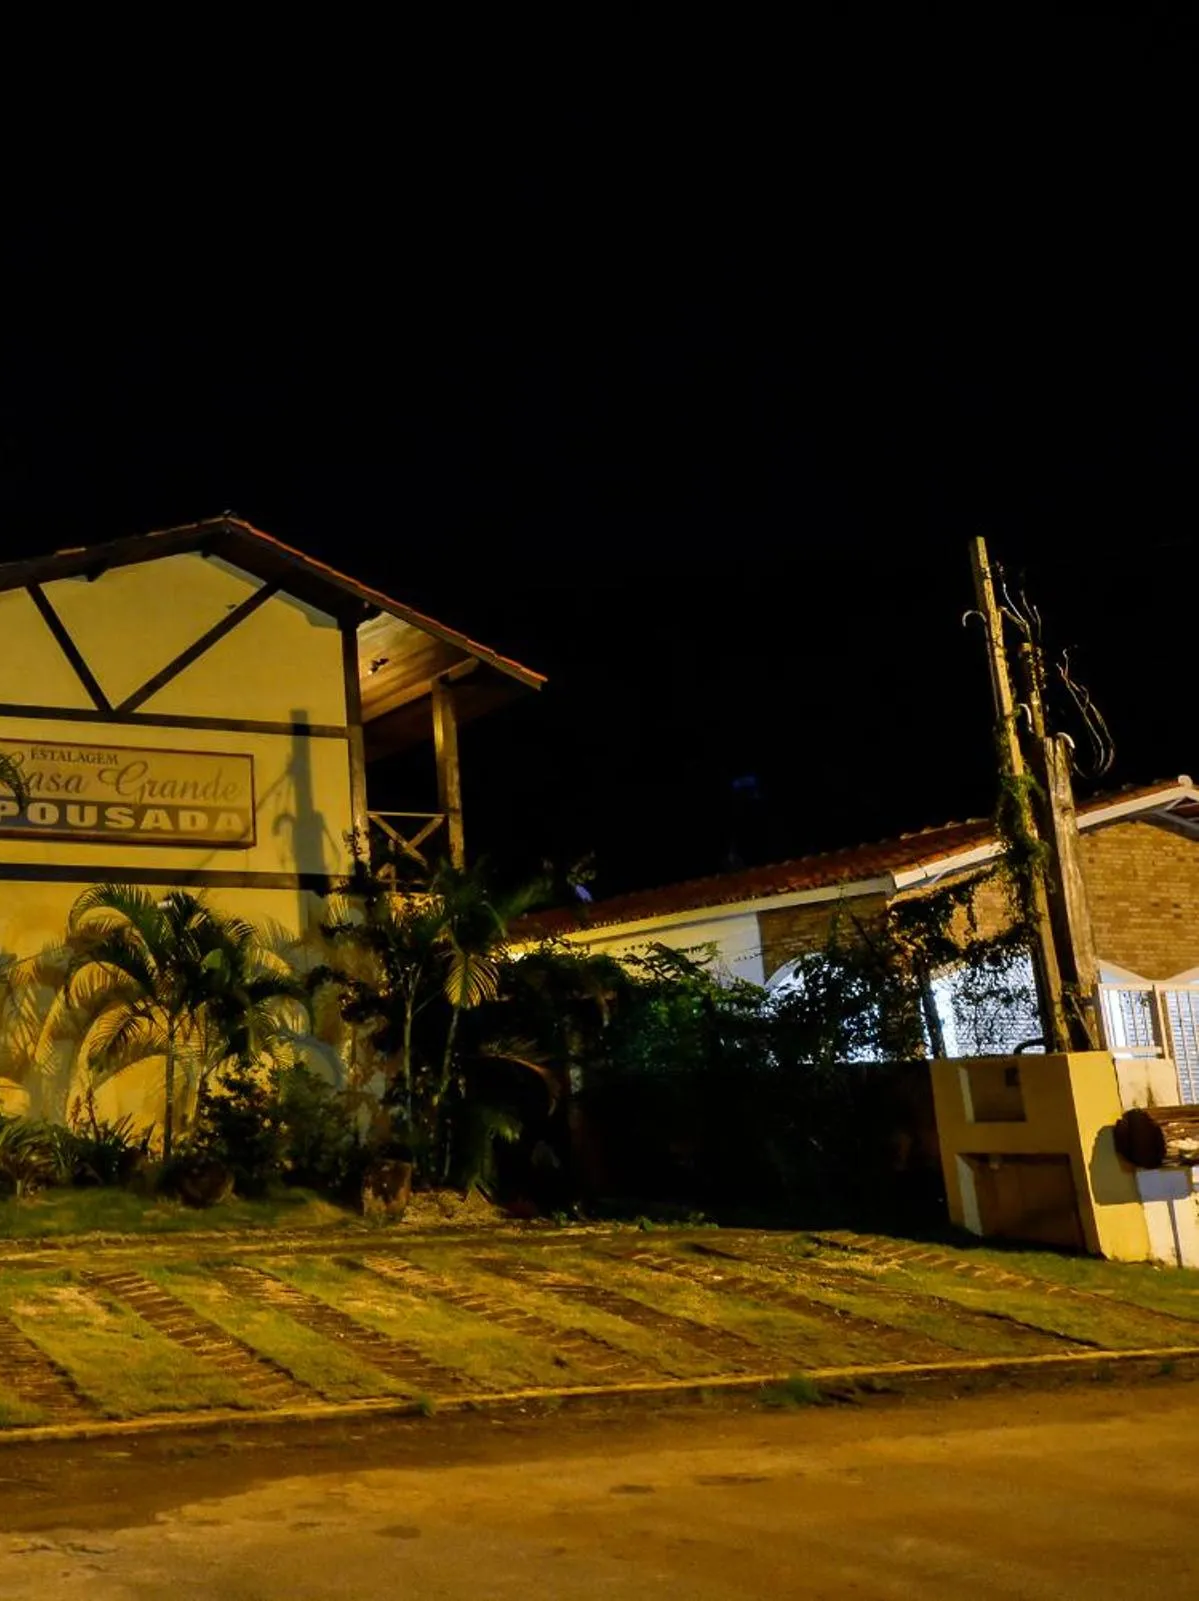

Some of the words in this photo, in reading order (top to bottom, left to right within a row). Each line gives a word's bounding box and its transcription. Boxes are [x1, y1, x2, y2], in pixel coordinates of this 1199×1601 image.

[30, 746, 119, 766] ESTALAGEM
[5, 751, 89, 795] asa
[97, 760, 243, 804] Grande
